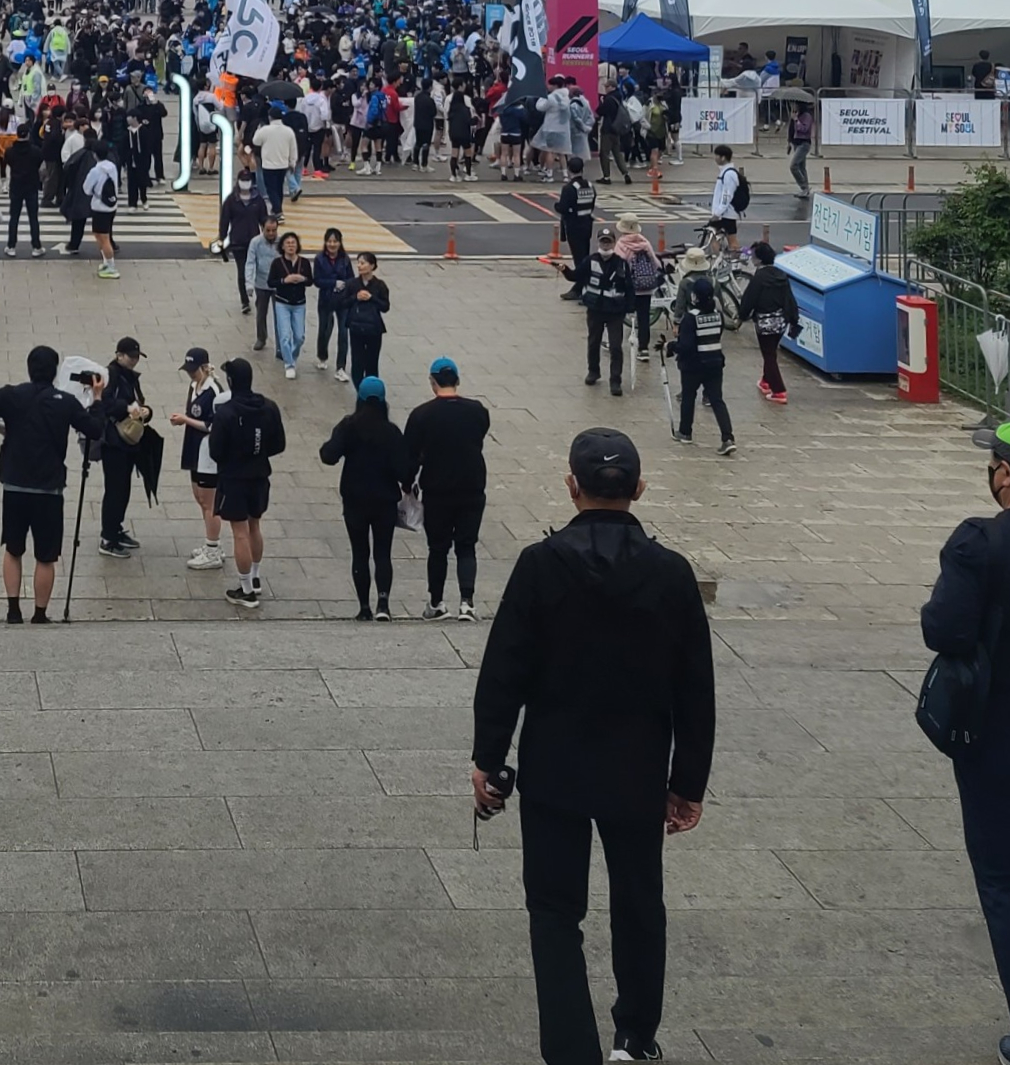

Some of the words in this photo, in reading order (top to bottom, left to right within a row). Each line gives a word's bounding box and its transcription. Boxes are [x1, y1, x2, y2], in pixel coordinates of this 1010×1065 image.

[700, 111, 725, 121] SEOUL
[839, 109, 870, 117] SEOUL
[945, 112, 971, 123] SEOUL
[695, 121, 707, 131] MY
[709, 121, 729, 131] SOUL
[847, 126, 891, 134] FESTIVAL
[954, 123, 976, 134] SOUL
[813, 203, 840, 236] 전단지
[843, 216, 873, 252] 수거함
